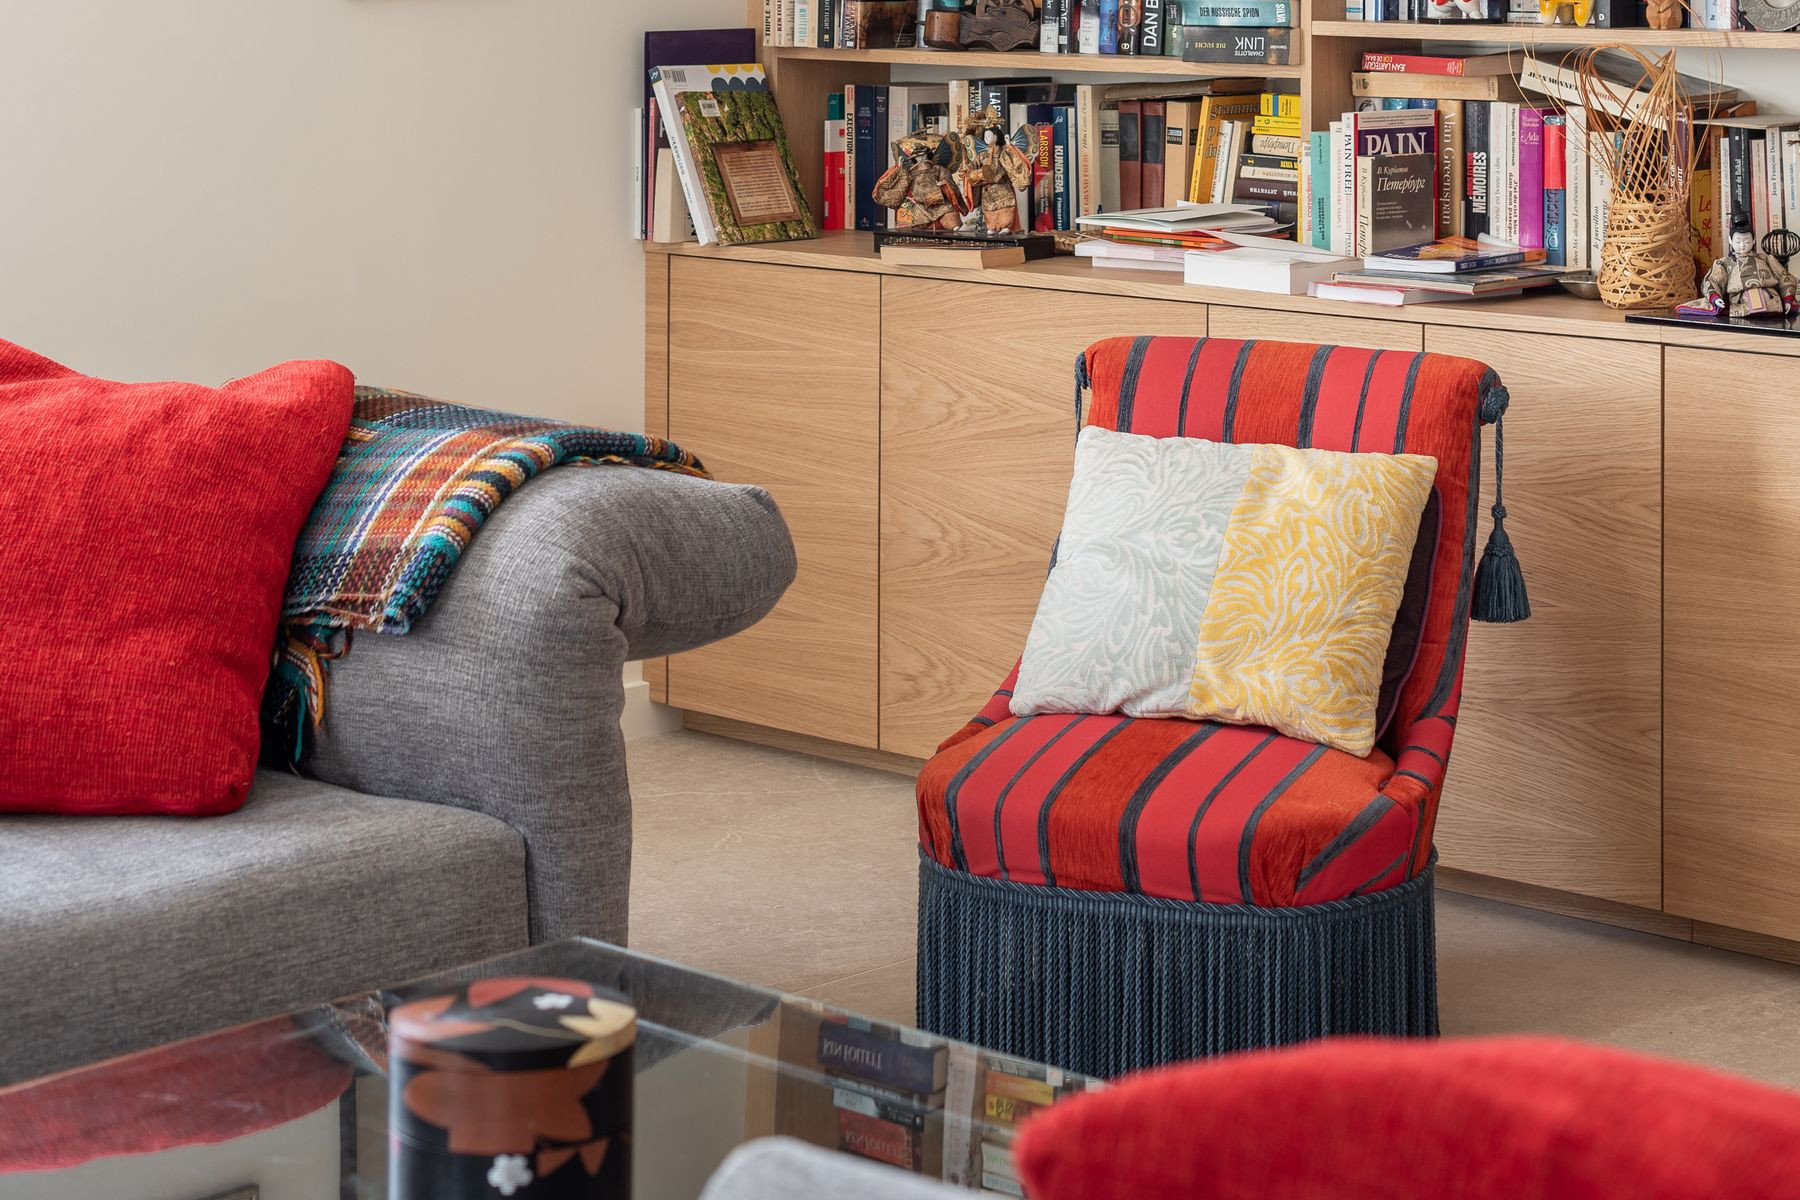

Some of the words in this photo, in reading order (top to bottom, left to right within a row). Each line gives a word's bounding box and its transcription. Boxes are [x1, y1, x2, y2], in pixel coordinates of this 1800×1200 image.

[1200, 8, 1210, 17] DER
[1211, 7, 1241, 17] RUSSISCHE
[1242, 7, 1260, 18] SPION
[1275, 3, 1286, 23] SILVA
[1143, 10, 1158, 47] DAN
[1235, 37, 1264, 50] LINK
[1392, 62, 1405, 72] JEAN
[1443, 112, 1456, 144] Alan
[1039, 130, 1049, 168] LARSSON
[1344, 134, 1353, 161] PAIN
[1365, 132, 1427, 157] PAIN
[1054, 145, 1064, 193] KUNDERA
[1344, 164, 1353, 195] FREE
[1470, 151, 1487, 213] MÉMOIRES
[1377, 176, 1426, 194] Петербург
[1442, 146, 1456, 225] Greenspan
